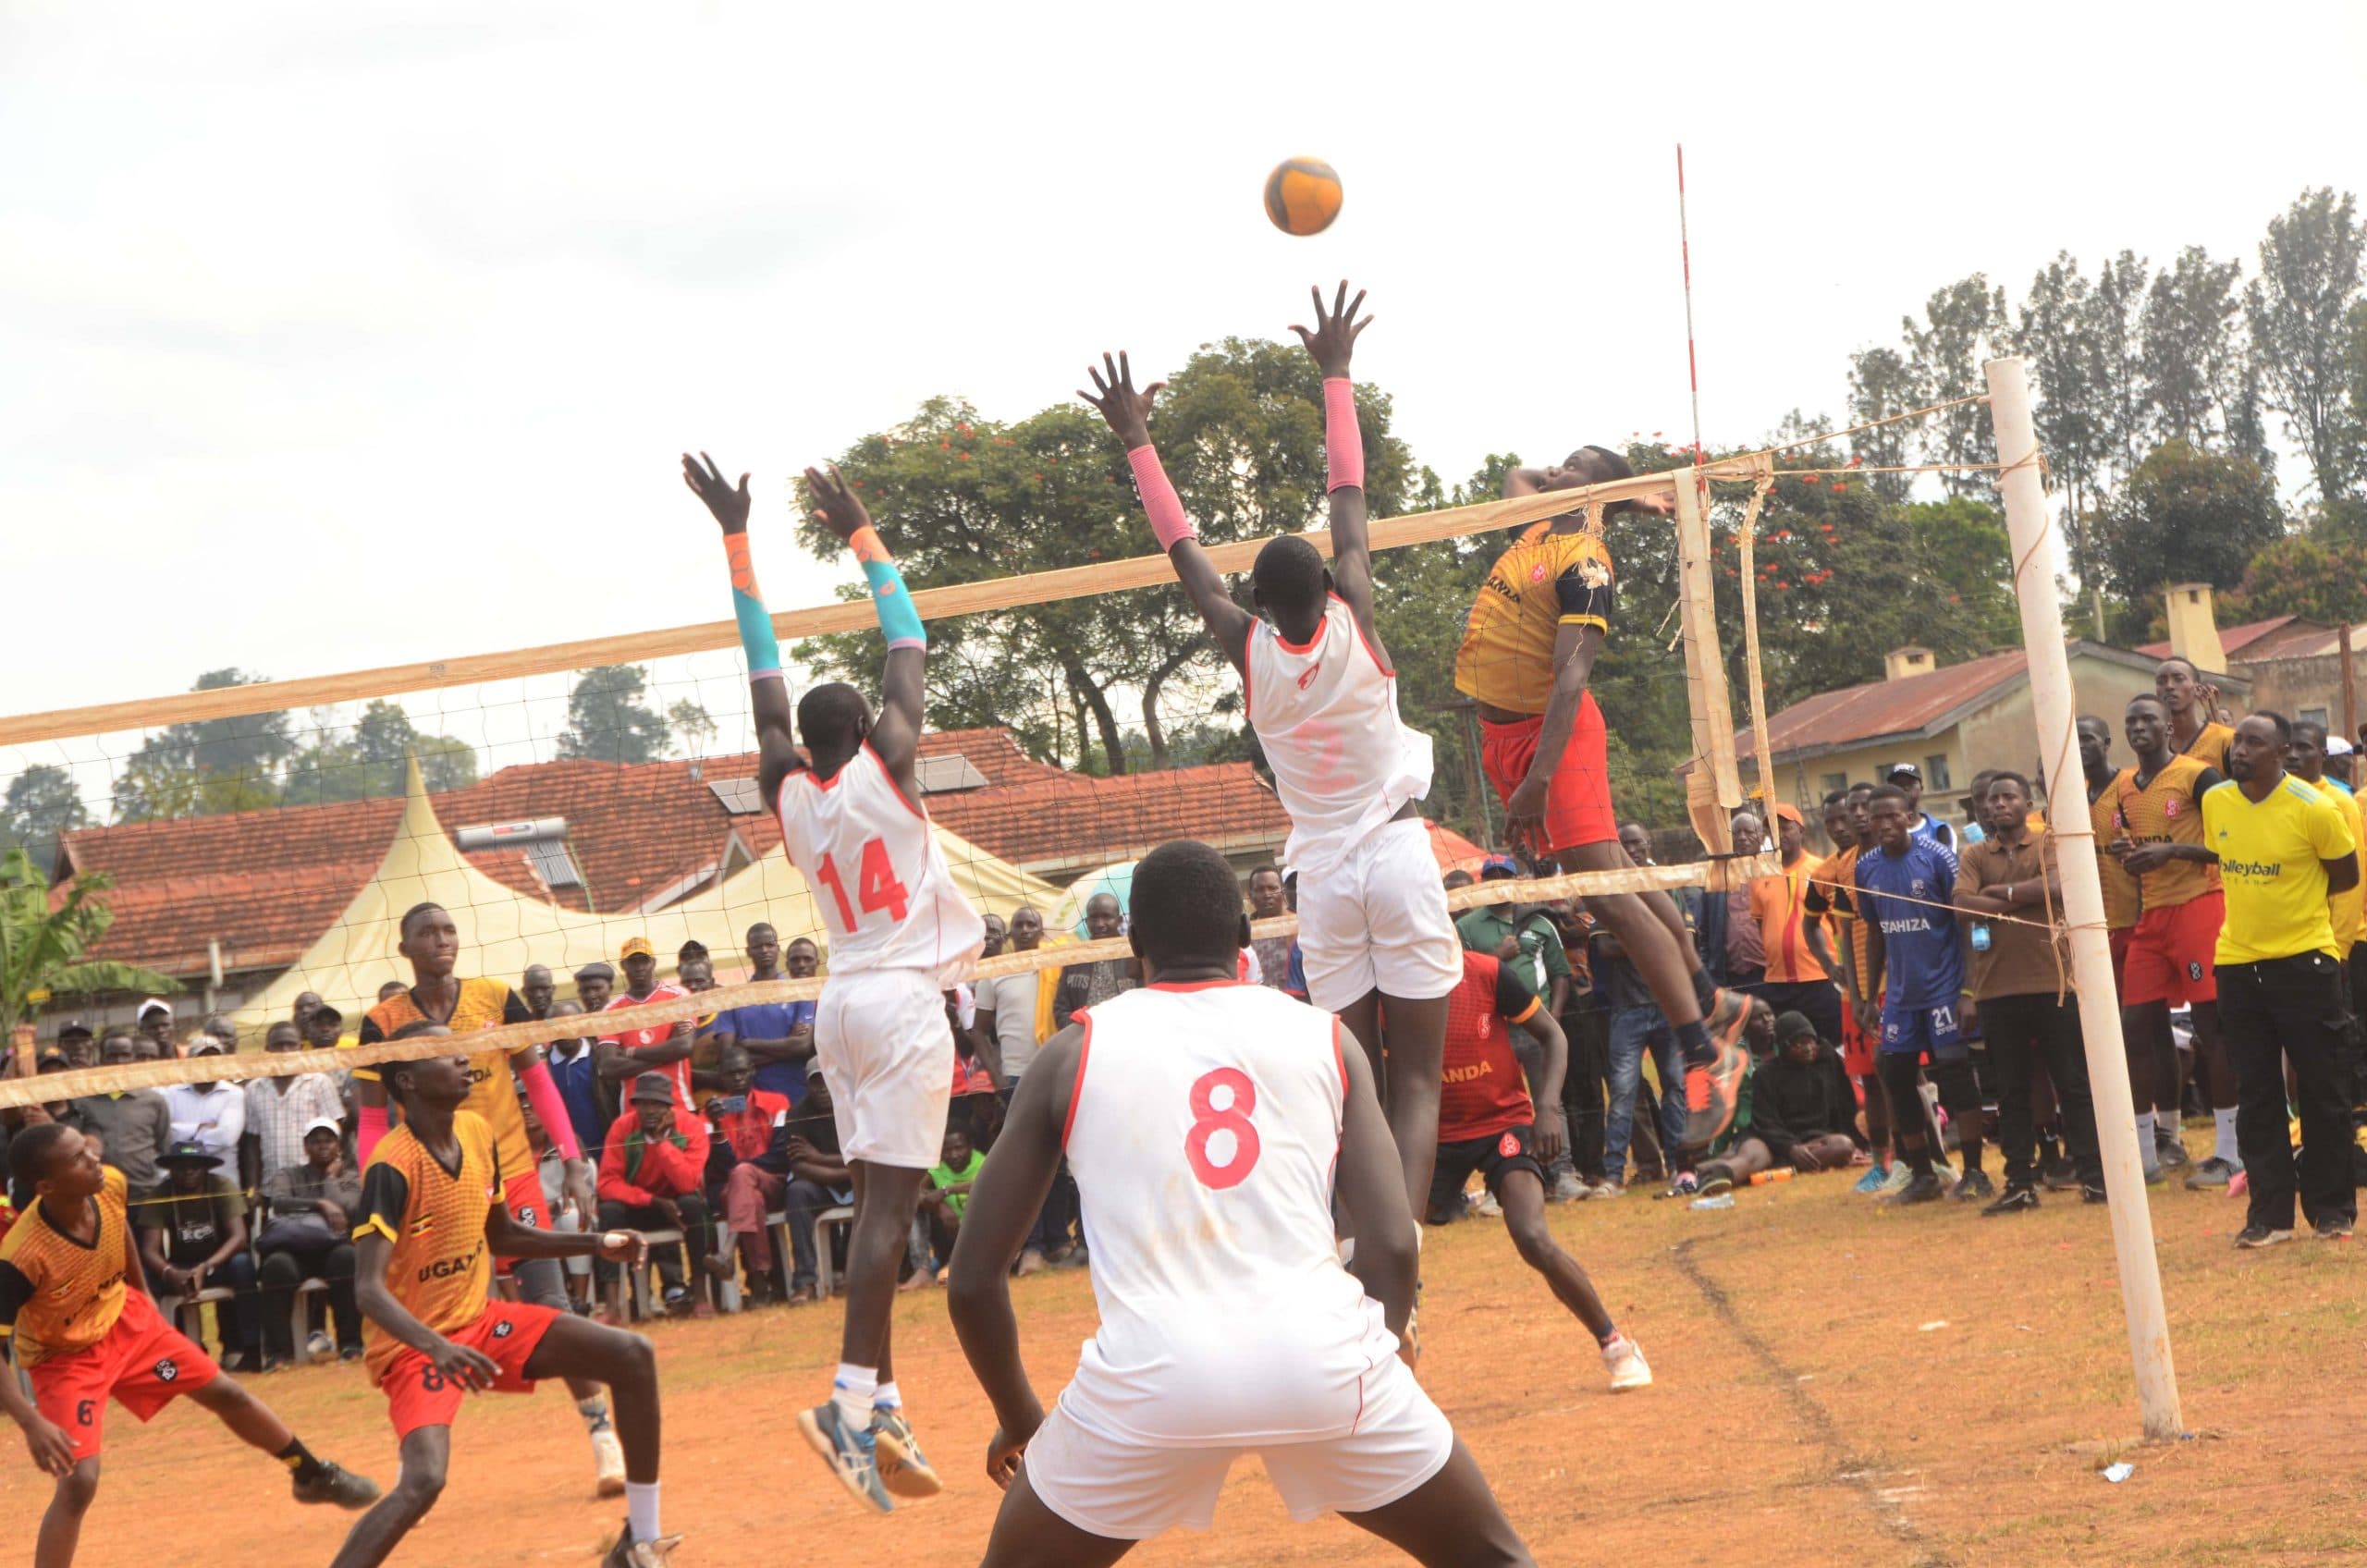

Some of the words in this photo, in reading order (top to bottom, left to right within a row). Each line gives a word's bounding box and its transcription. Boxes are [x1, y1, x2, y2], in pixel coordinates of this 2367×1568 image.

[816, 836, 909, 933] 14
[1932, 1005, 1953, 1028] 21
[1441, 1060, 1494, 1084] ANDA
[1184, 1067, 1260, 1190] 8
[422, 1365, 444, 1391] 8
[77, 1399, 96, 1427] 6
